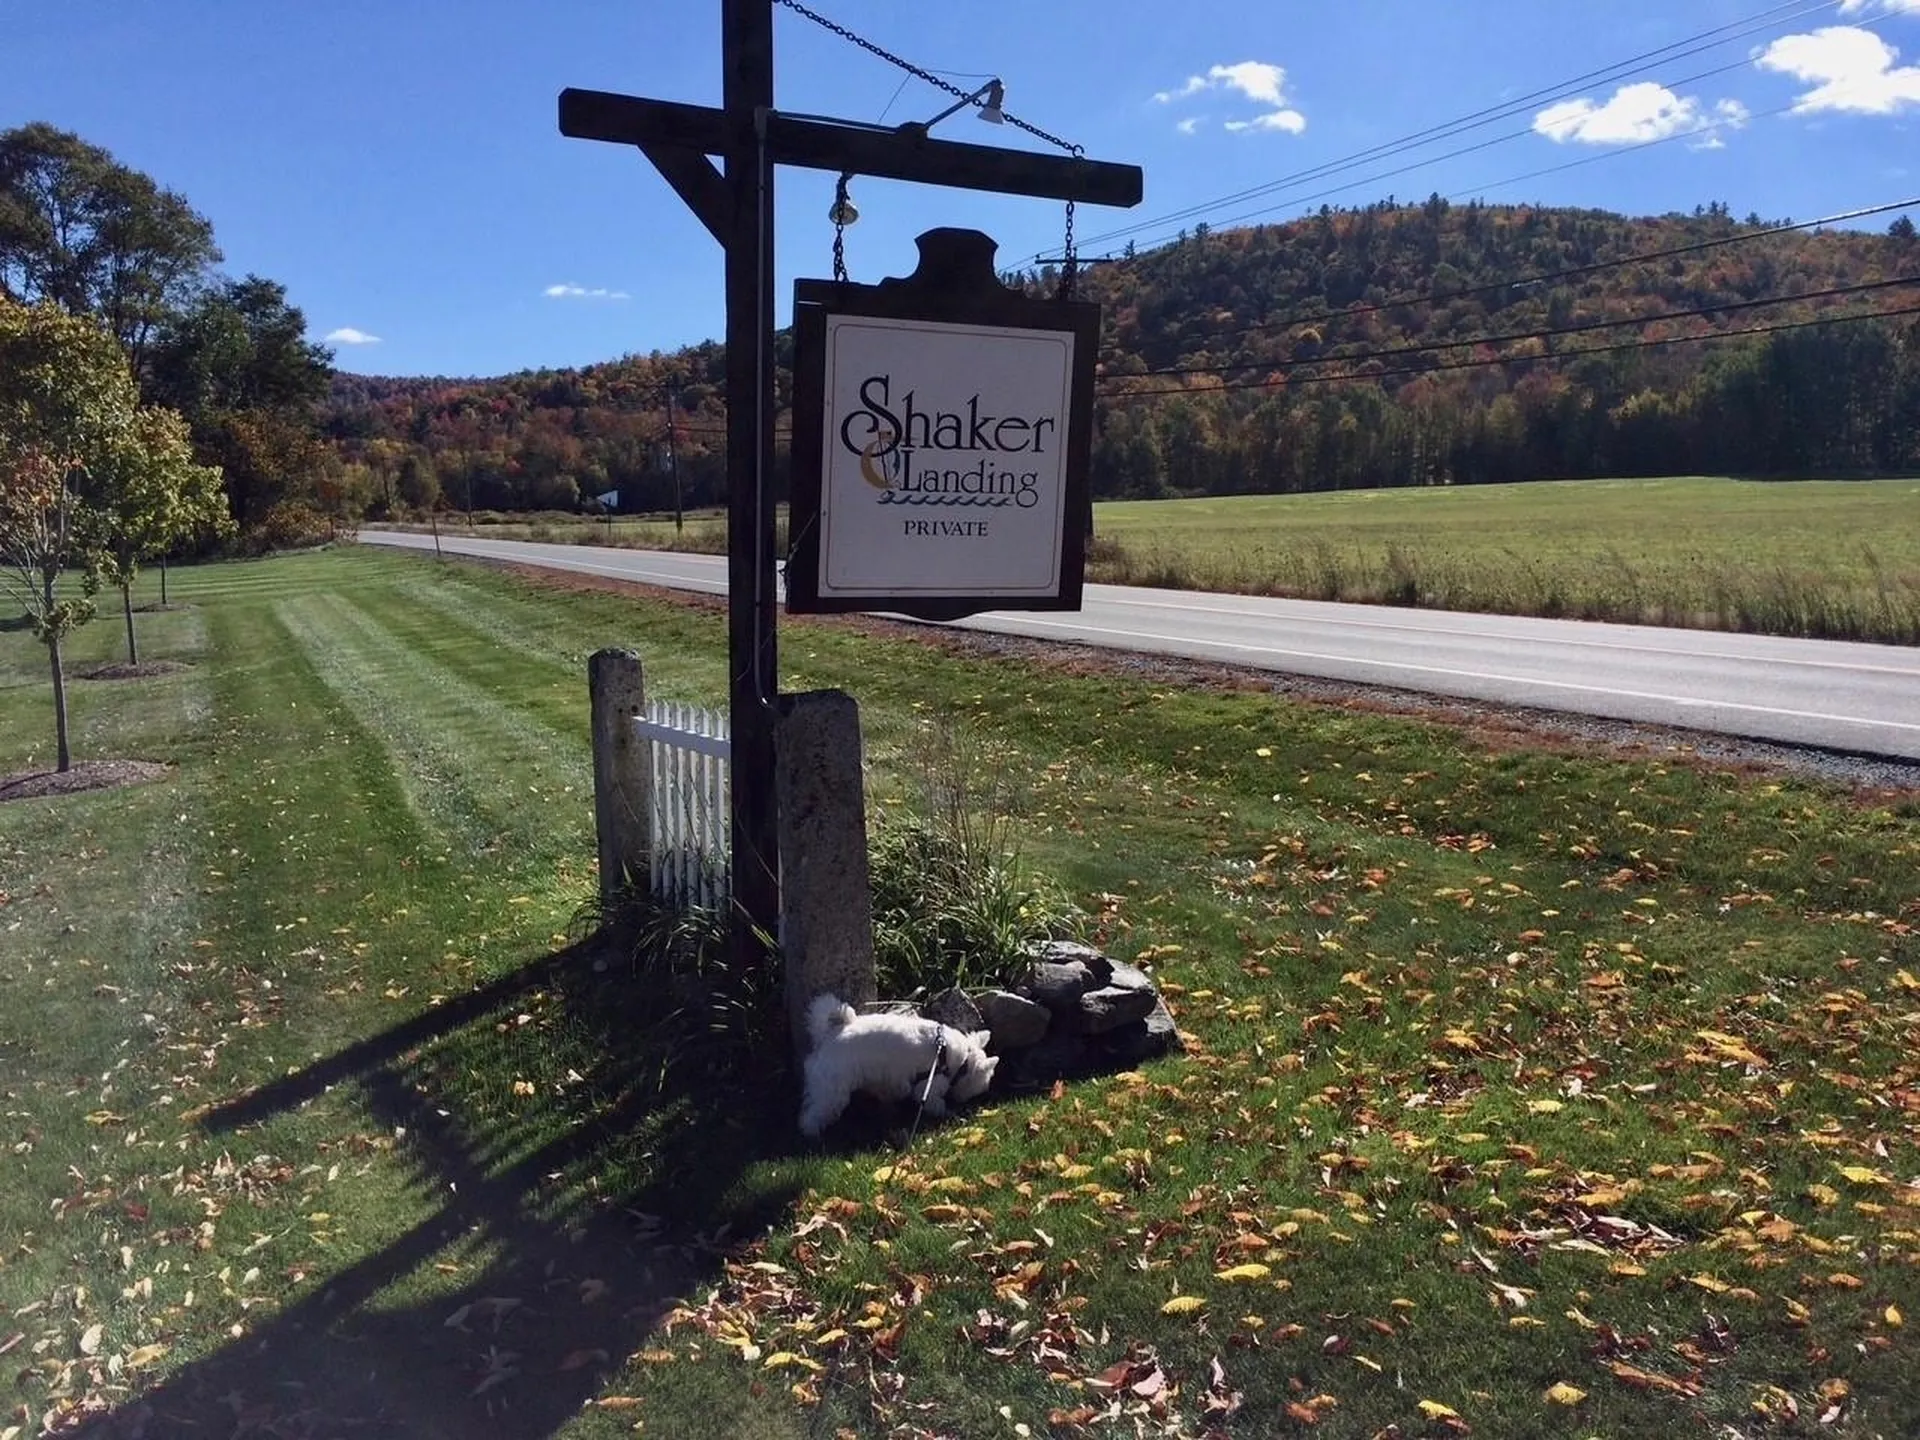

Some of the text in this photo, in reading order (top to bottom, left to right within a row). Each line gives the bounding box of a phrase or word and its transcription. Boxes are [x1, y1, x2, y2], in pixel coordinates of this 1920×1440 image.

[840, 375, 1055, 458] Shaker
[899, 450, 1039, 508] Landing
[903, 519, 989, 537] PRIVATE
